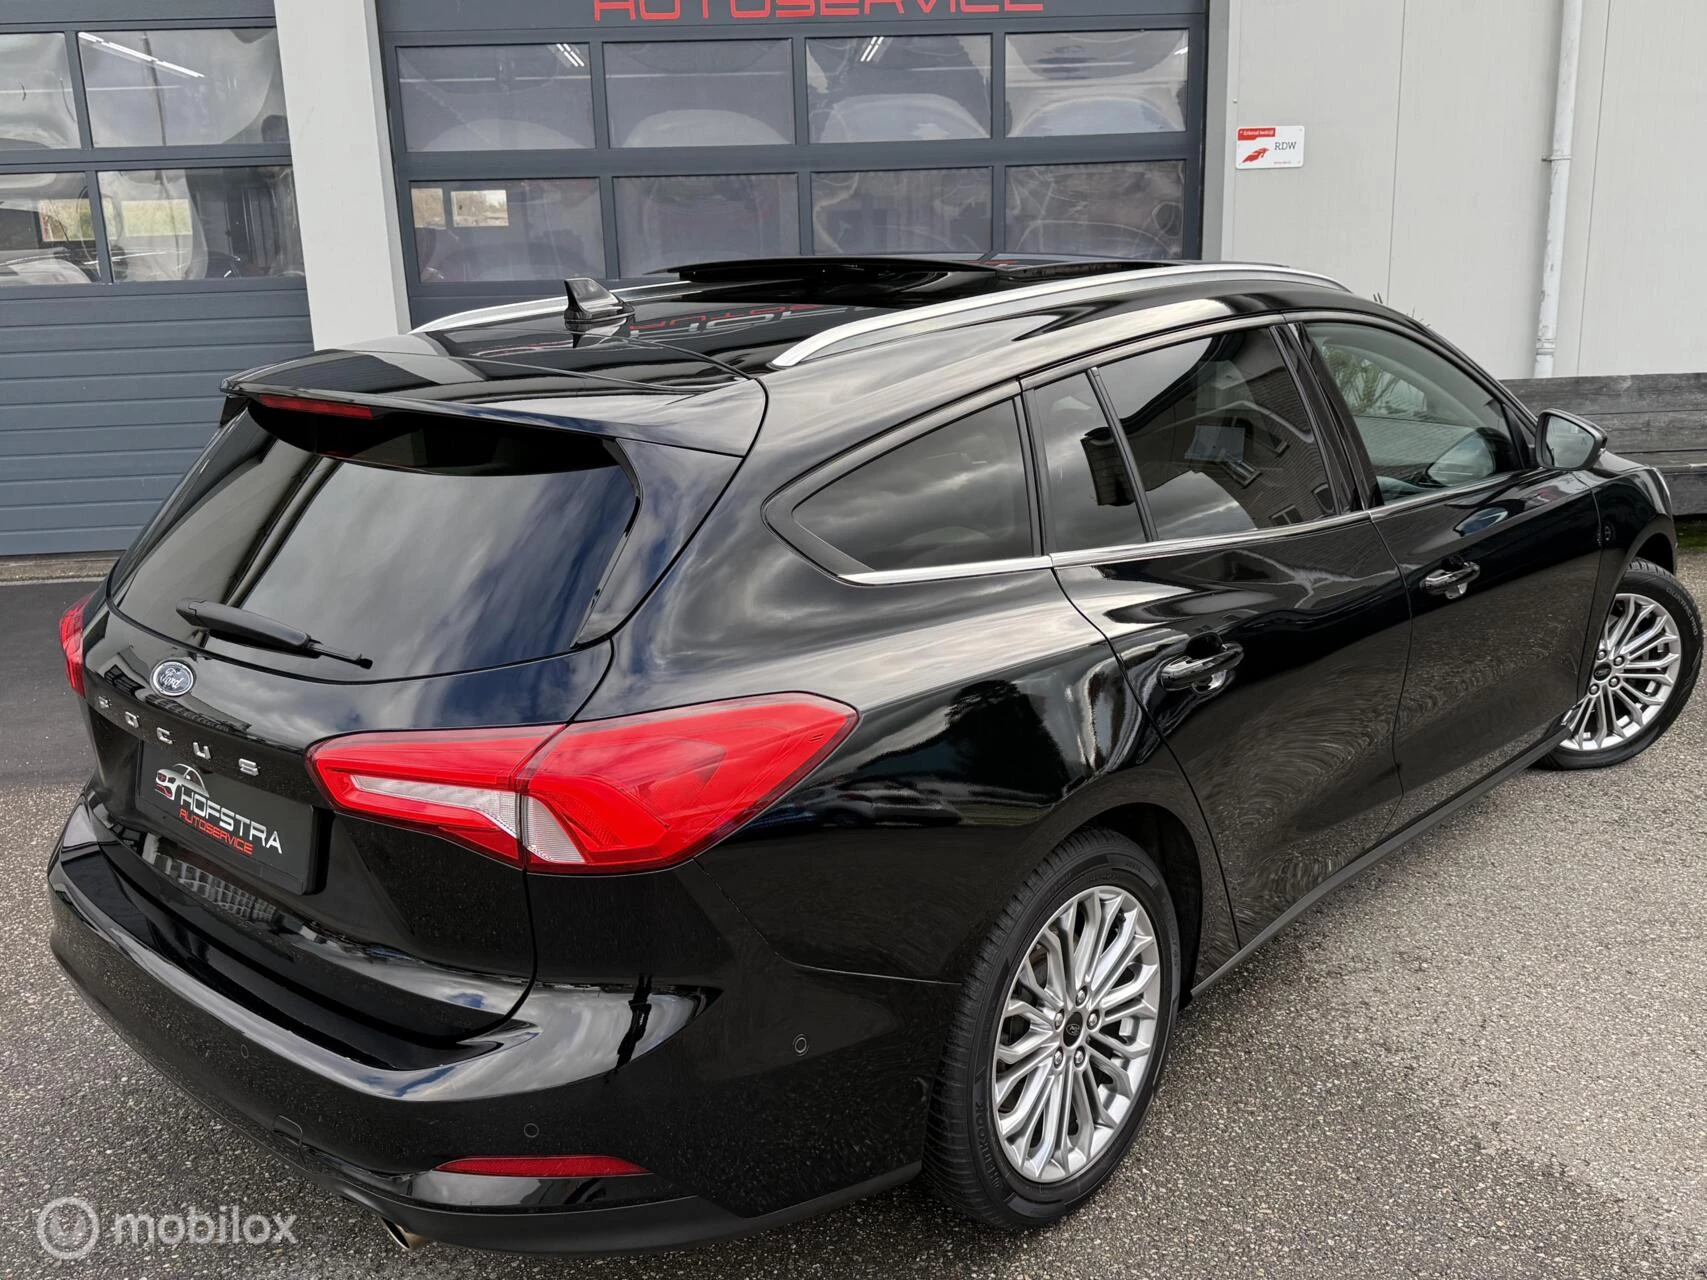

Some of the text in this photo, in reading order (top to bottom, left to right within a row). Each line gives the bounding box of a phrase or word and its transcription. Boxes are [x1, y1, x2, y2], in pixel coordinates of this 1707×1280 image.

[1274, 141, 1297, 151] RDW
[160, 667, 185, 690] Ford
[98, 695, 260, 777] FOCUS
[178, 808, 255, 856] AUTOSERVICE
[180, 786, 283, 855] HOFSTRA
